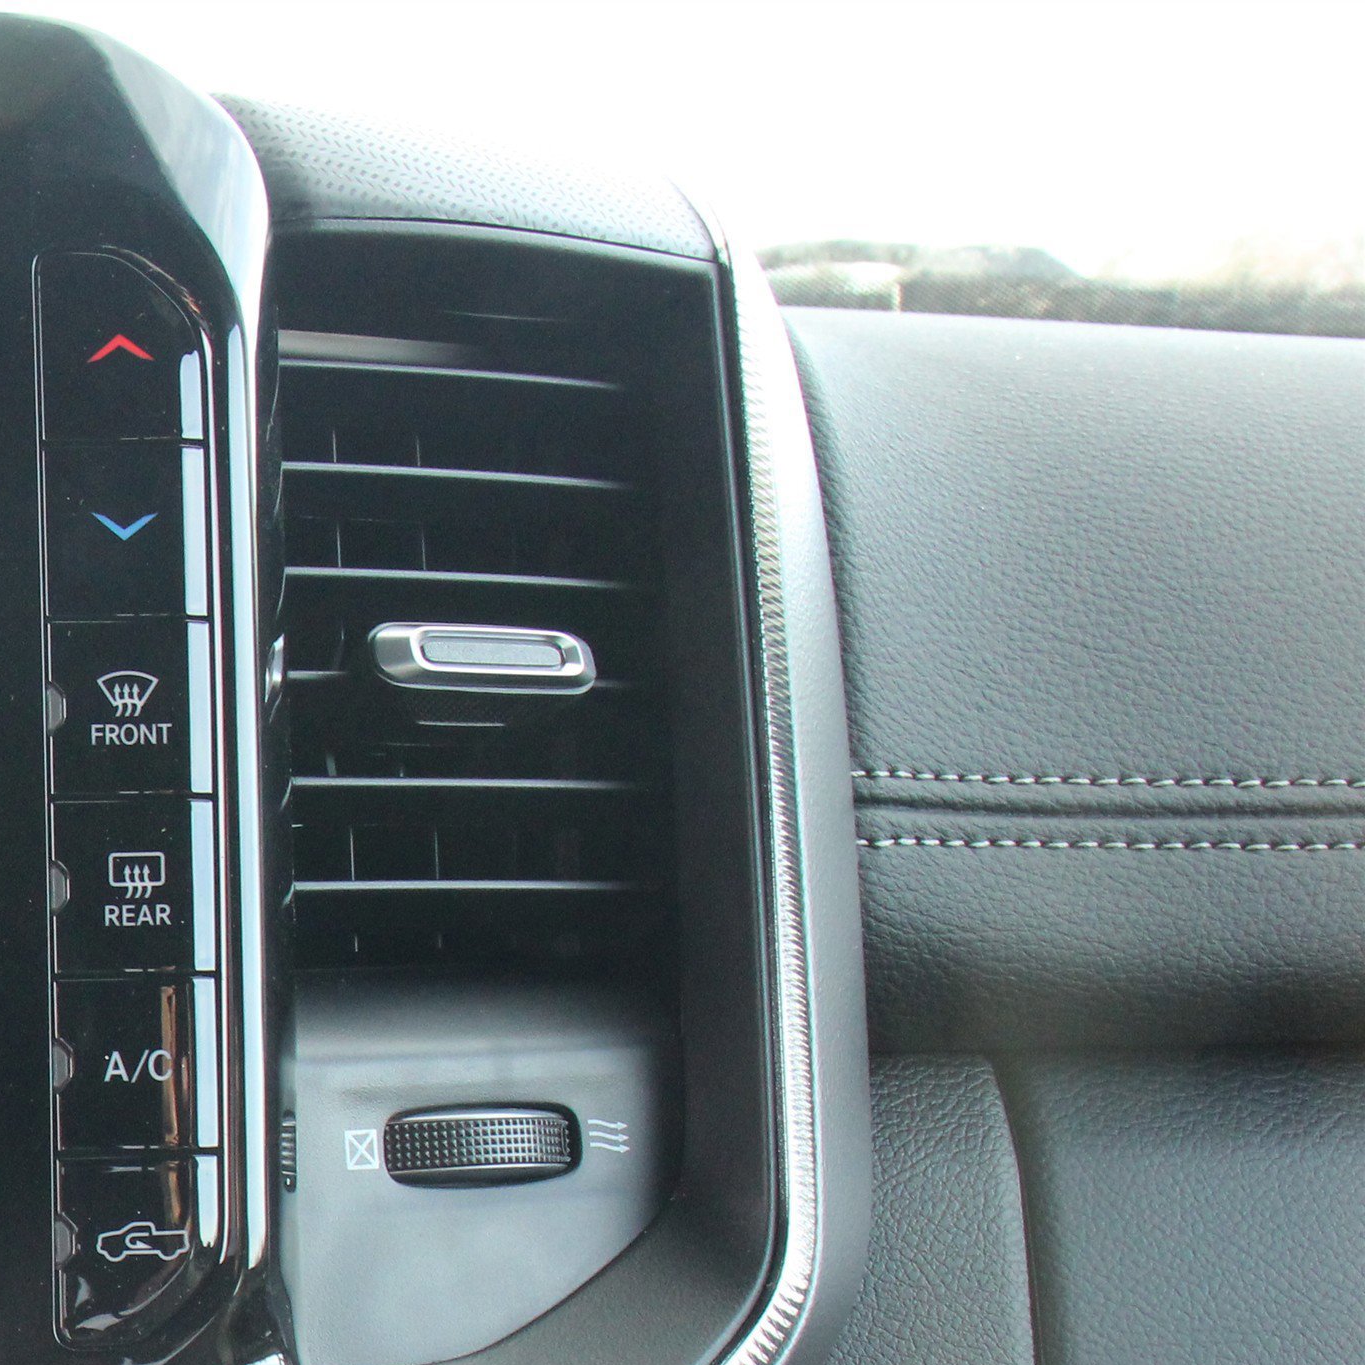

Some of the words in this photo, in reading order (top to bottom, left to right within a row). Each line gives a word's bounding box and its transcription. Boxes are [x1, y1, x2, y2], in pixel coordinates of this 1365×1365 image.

[90, 723, 172, 746] FRONT
[104, 904, 171, 927] REAR
[104, 1049, 174, 1083] A/C
